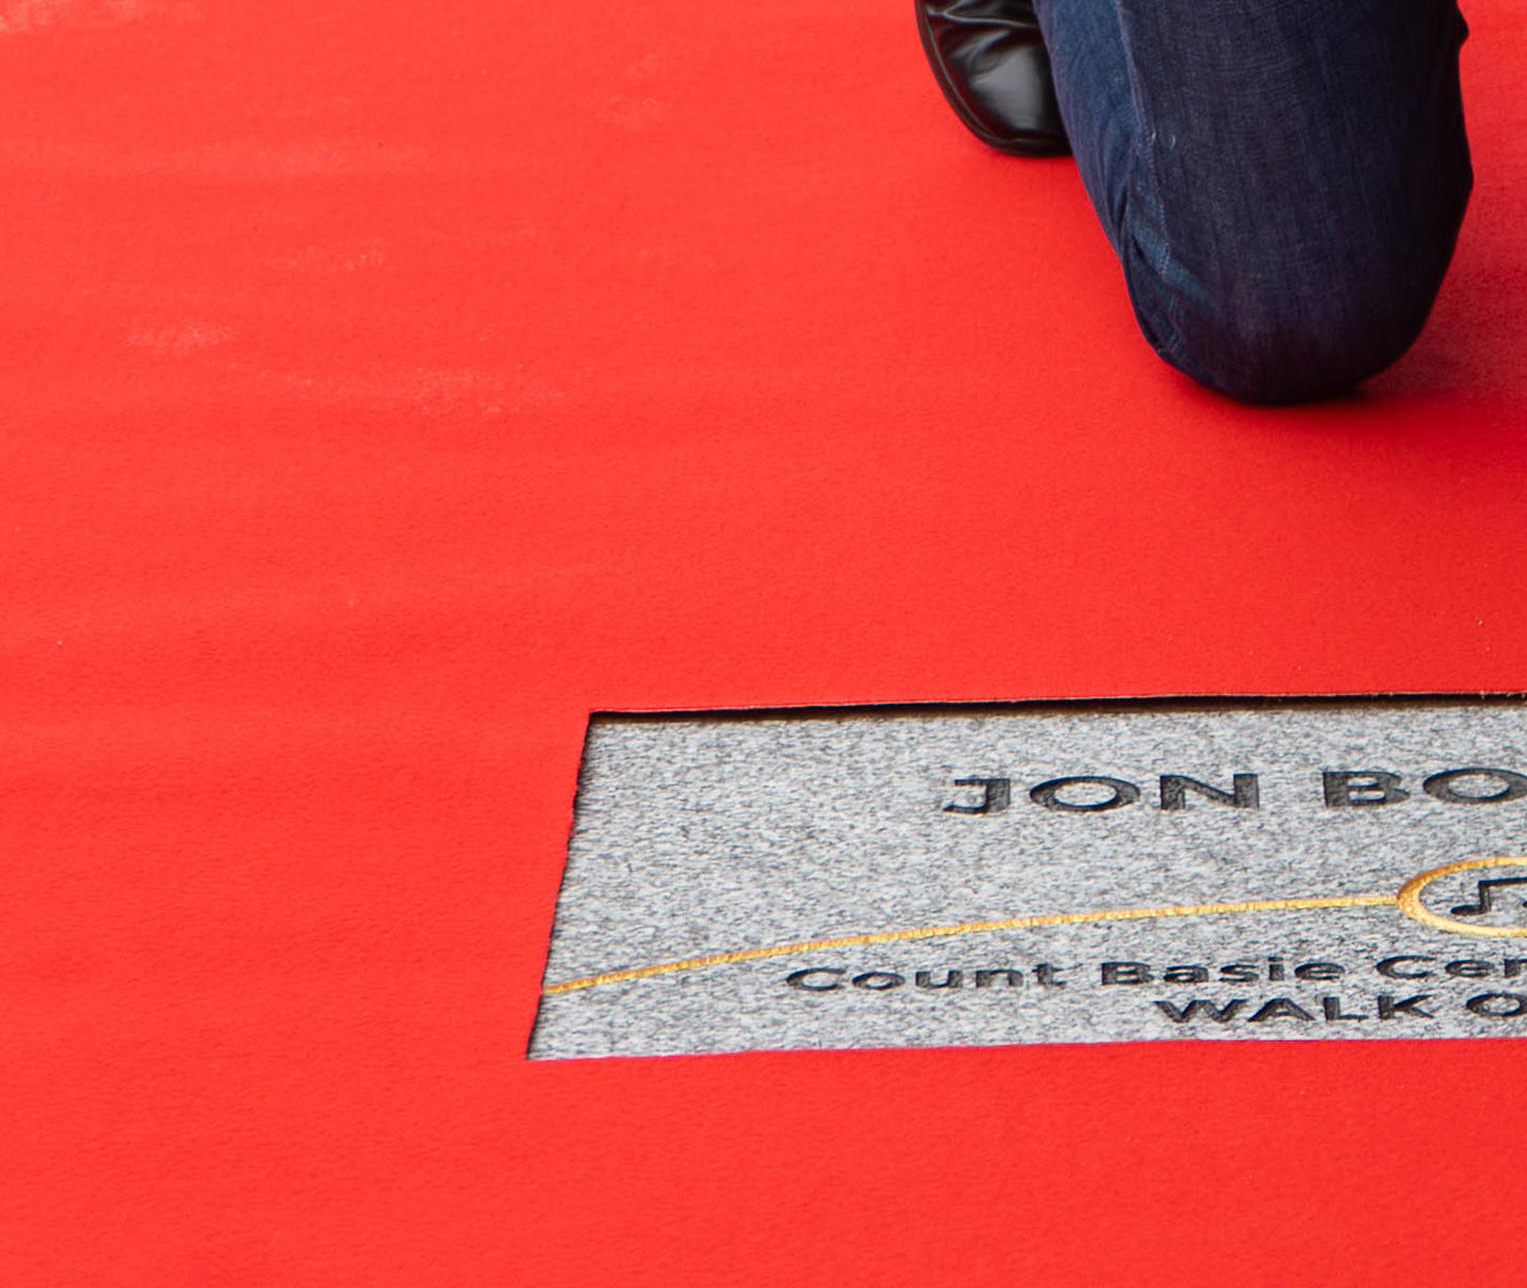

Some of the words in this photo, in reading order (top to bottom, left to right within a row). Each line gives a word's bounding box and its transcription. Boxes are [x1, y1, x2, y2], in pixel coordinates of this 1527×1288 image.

[942, 772, 1260, 815] JON
[785, 962, 1067, 993] Count
[1100, 955, 1344, 986] Basie
[1153, 993, 1437, 1025] WALK
